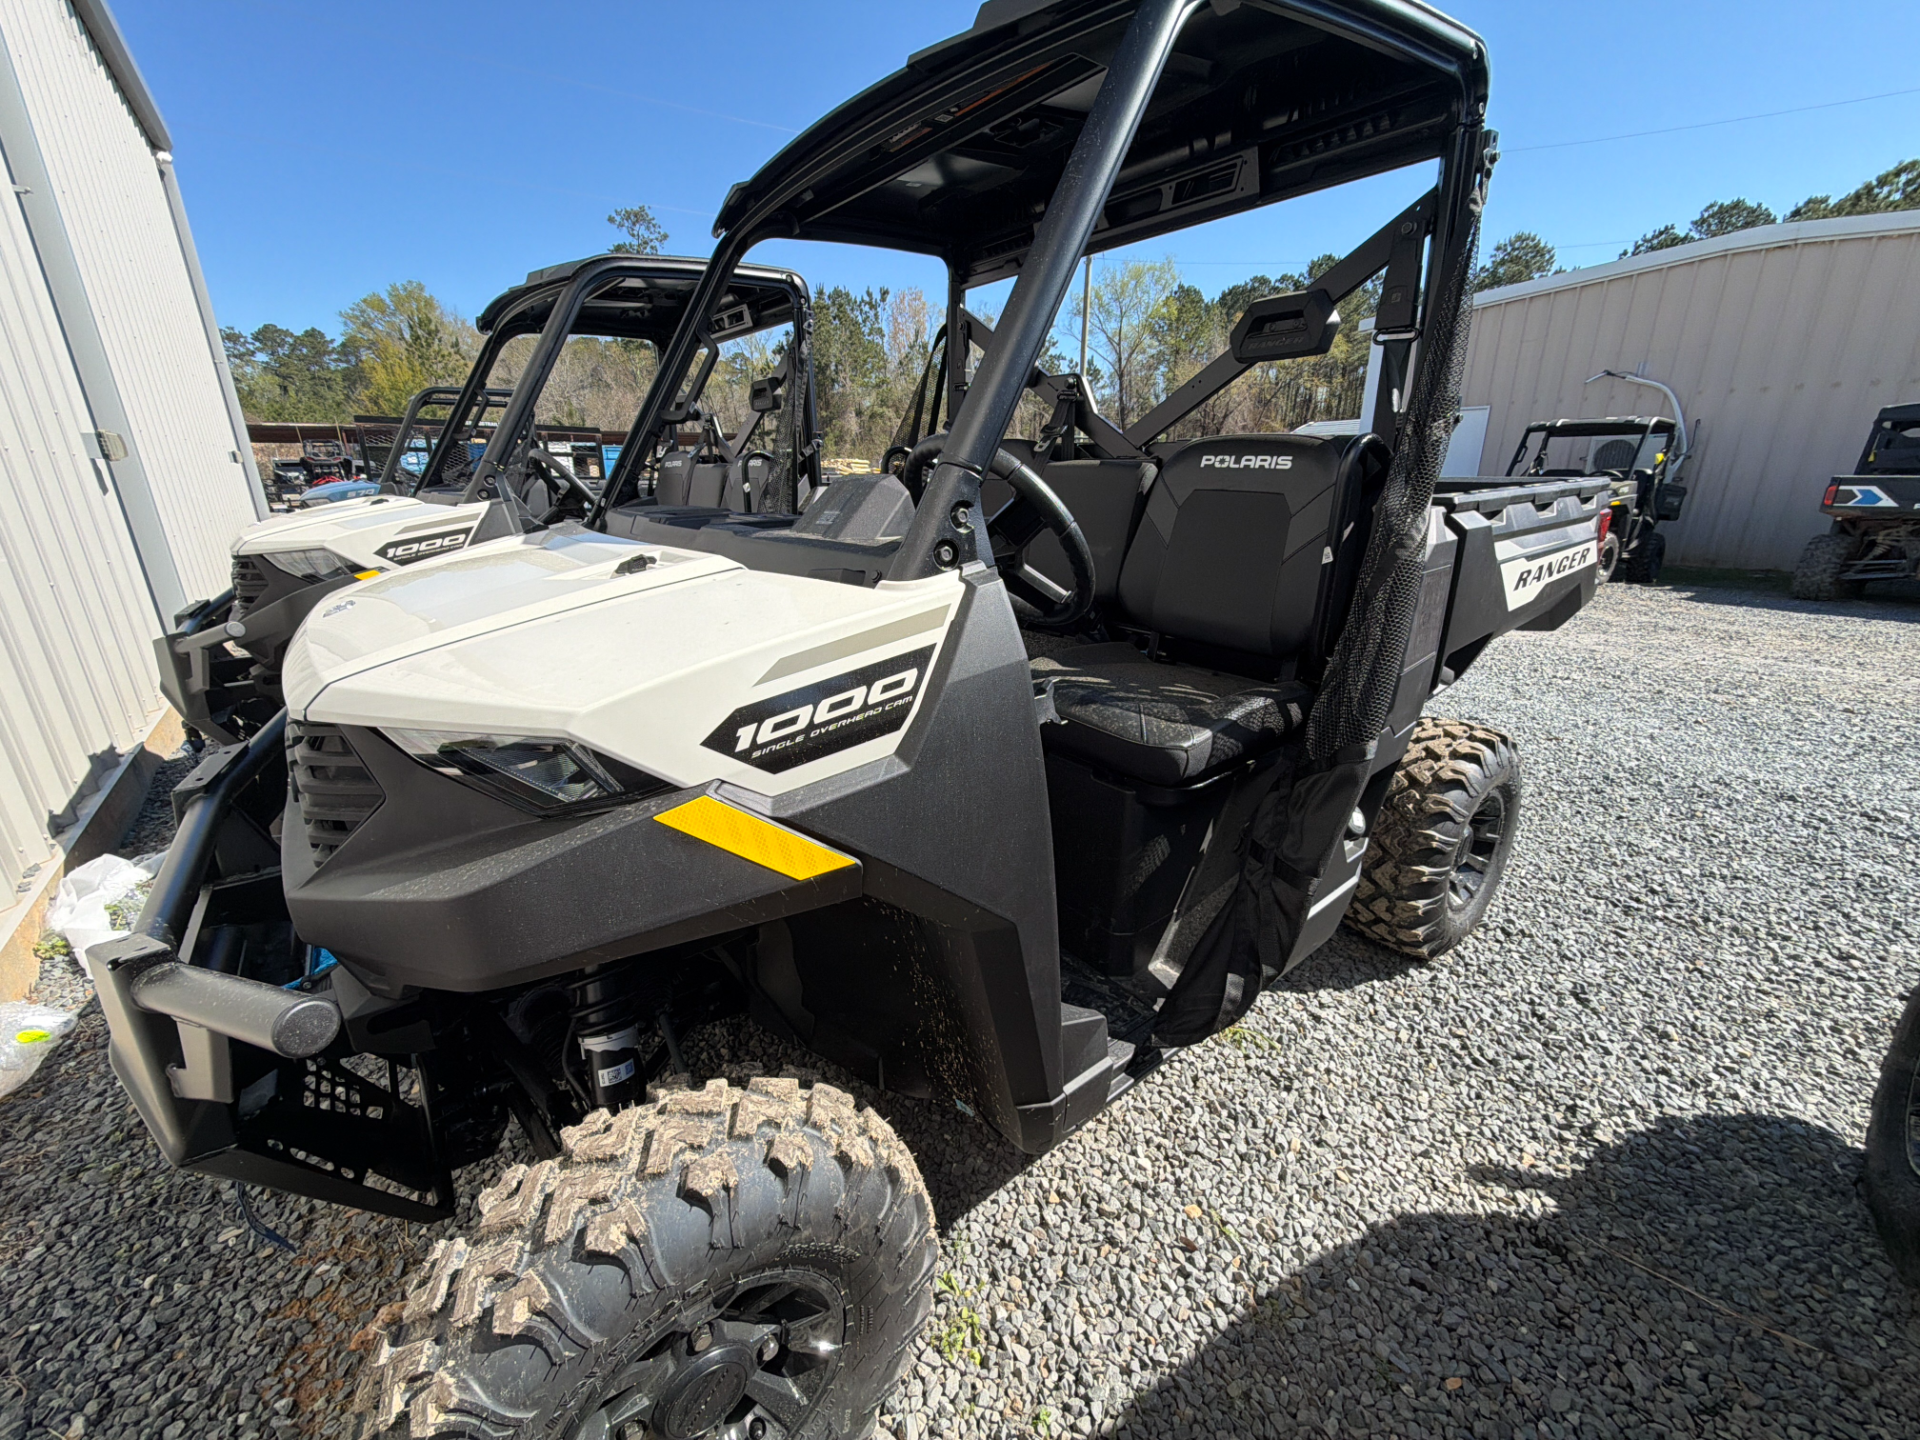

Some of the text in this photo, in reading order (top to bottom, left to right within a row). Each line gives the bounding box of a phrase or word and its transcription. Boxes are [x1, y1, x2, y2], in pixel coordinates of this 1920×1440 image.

[1200, 455, 1293, 469] POLARIS
[347, 489, 375, 498] 570
[386, 534, 466, 558] 1000
[1513, 547, 1591, 592] RANGER
[734, 667, 918, 753] 1000
[751, 695, 914, 759] SINGLE OVERHEAD CAM
